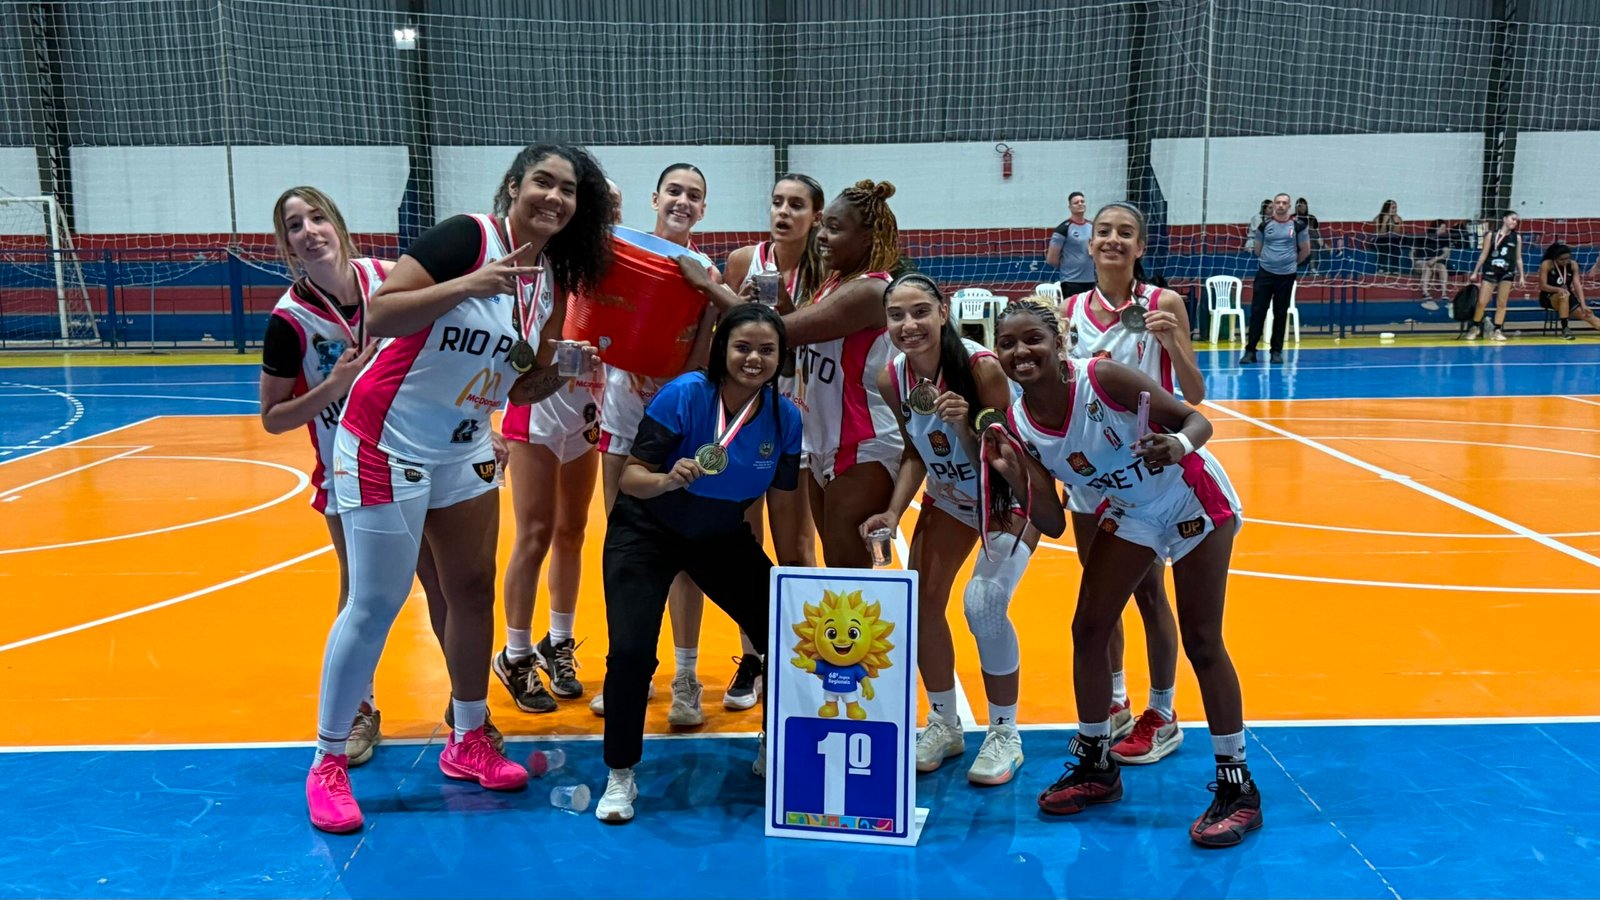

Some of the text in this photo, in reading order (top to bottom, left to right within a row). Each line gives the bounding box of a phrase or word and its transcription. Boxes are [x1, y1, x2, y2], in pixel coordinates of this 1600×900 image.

[439, 326, 514, 363] RIO P
[479, 463, 495, 475] UP
[1181, 520, 1201, 535] UP
[817, 731, 872, 816] 1º
